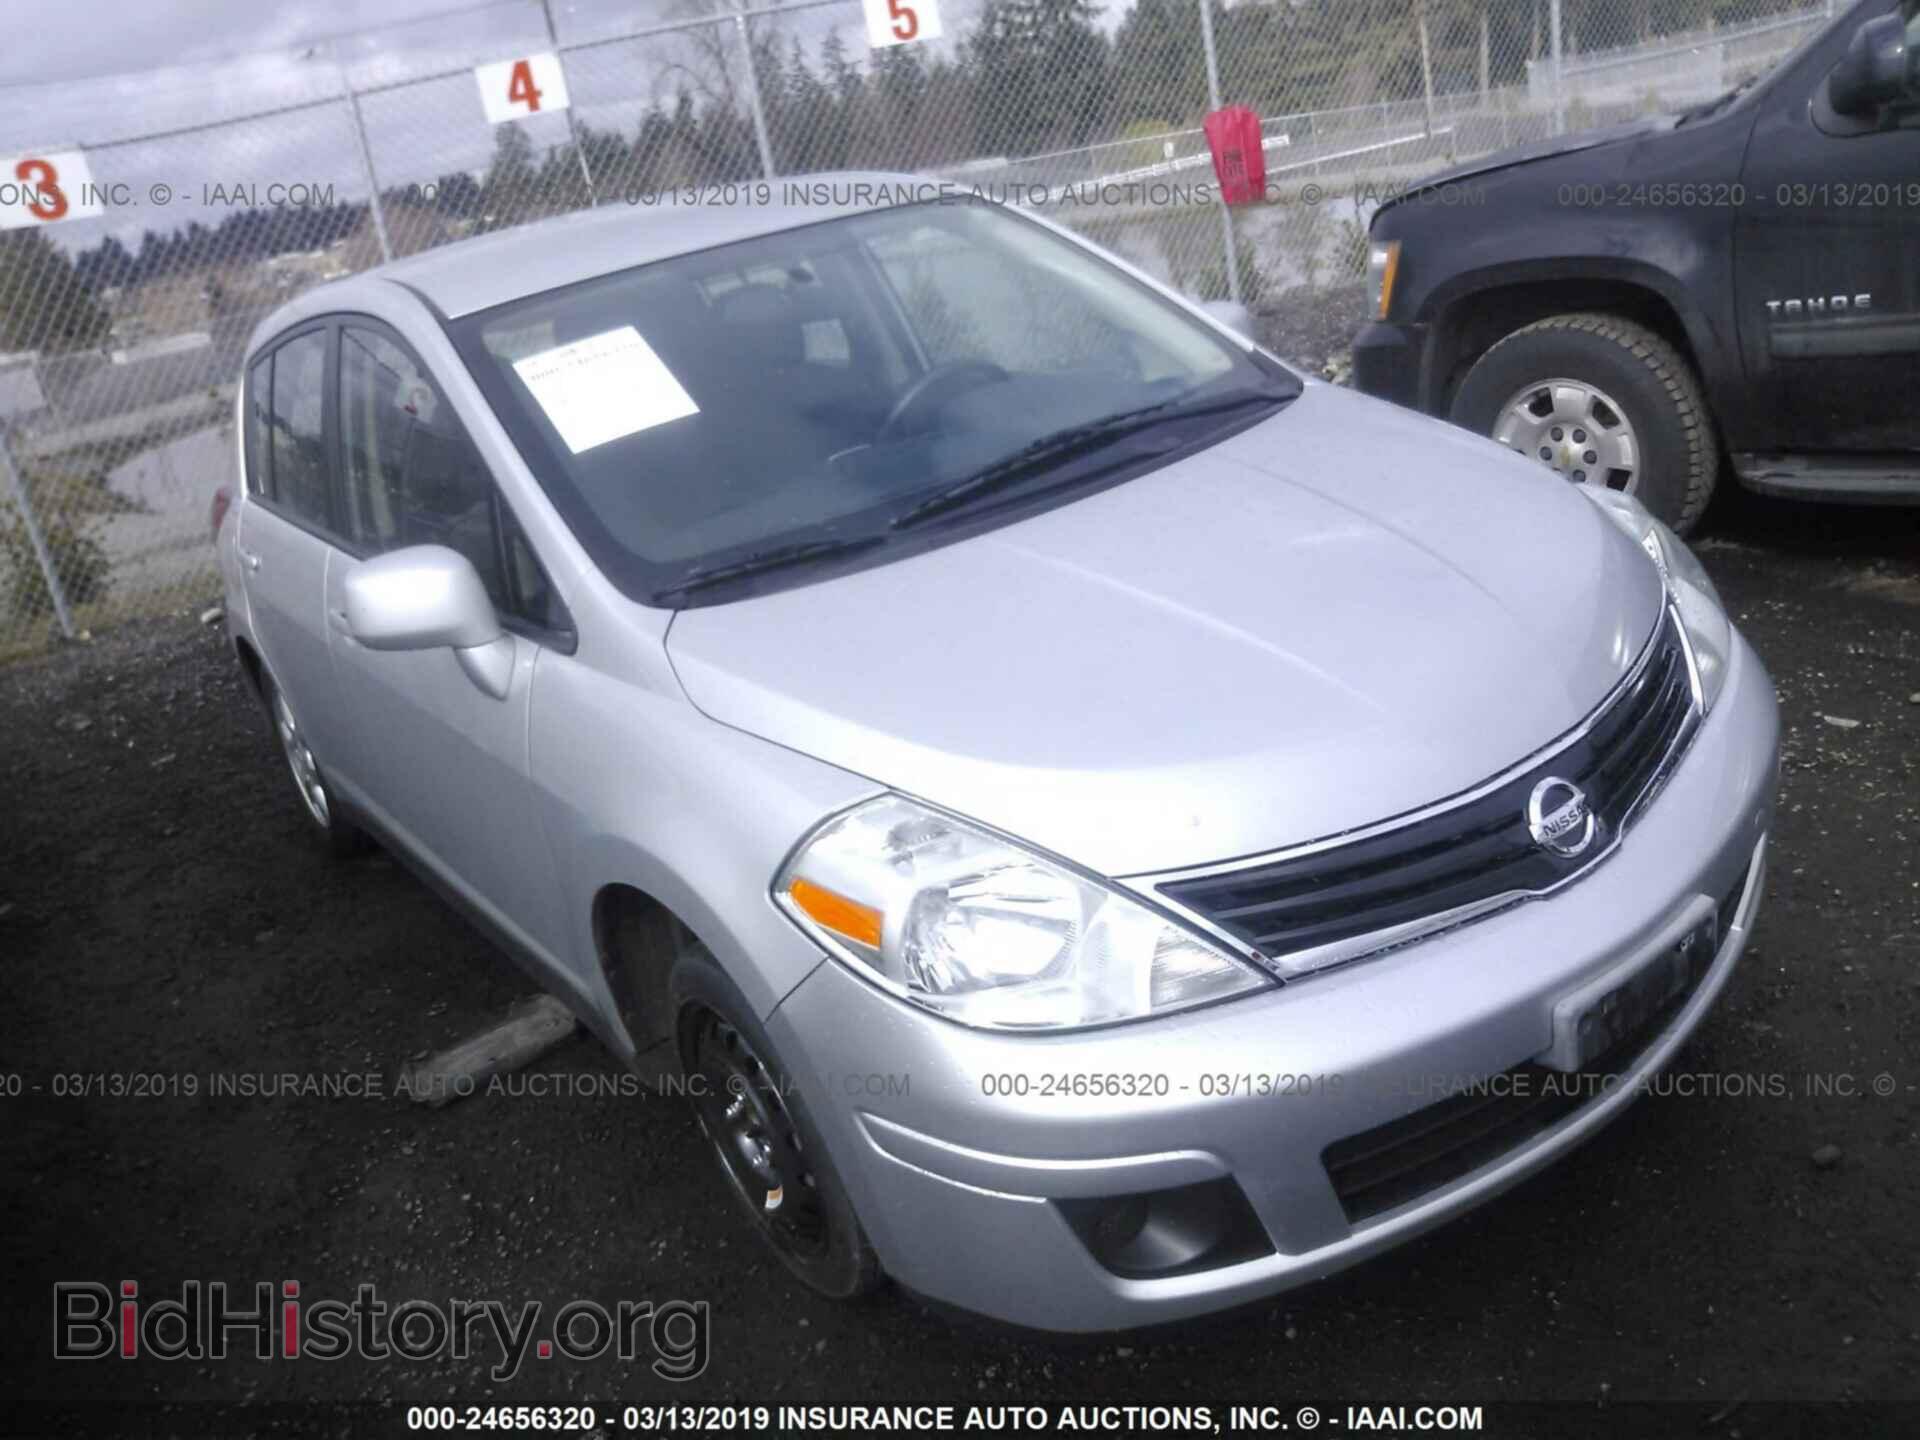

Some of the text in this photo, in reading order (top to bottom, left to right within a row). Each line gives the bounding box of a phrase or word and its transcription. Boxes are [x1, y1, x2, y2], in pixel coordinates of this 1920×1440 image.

[887, 0, 919, 41] 5
[508, 60, 543, 112] 4
[16, 160, 68, 221] 3
[1765, 294, 1871, 314] TAHOE
